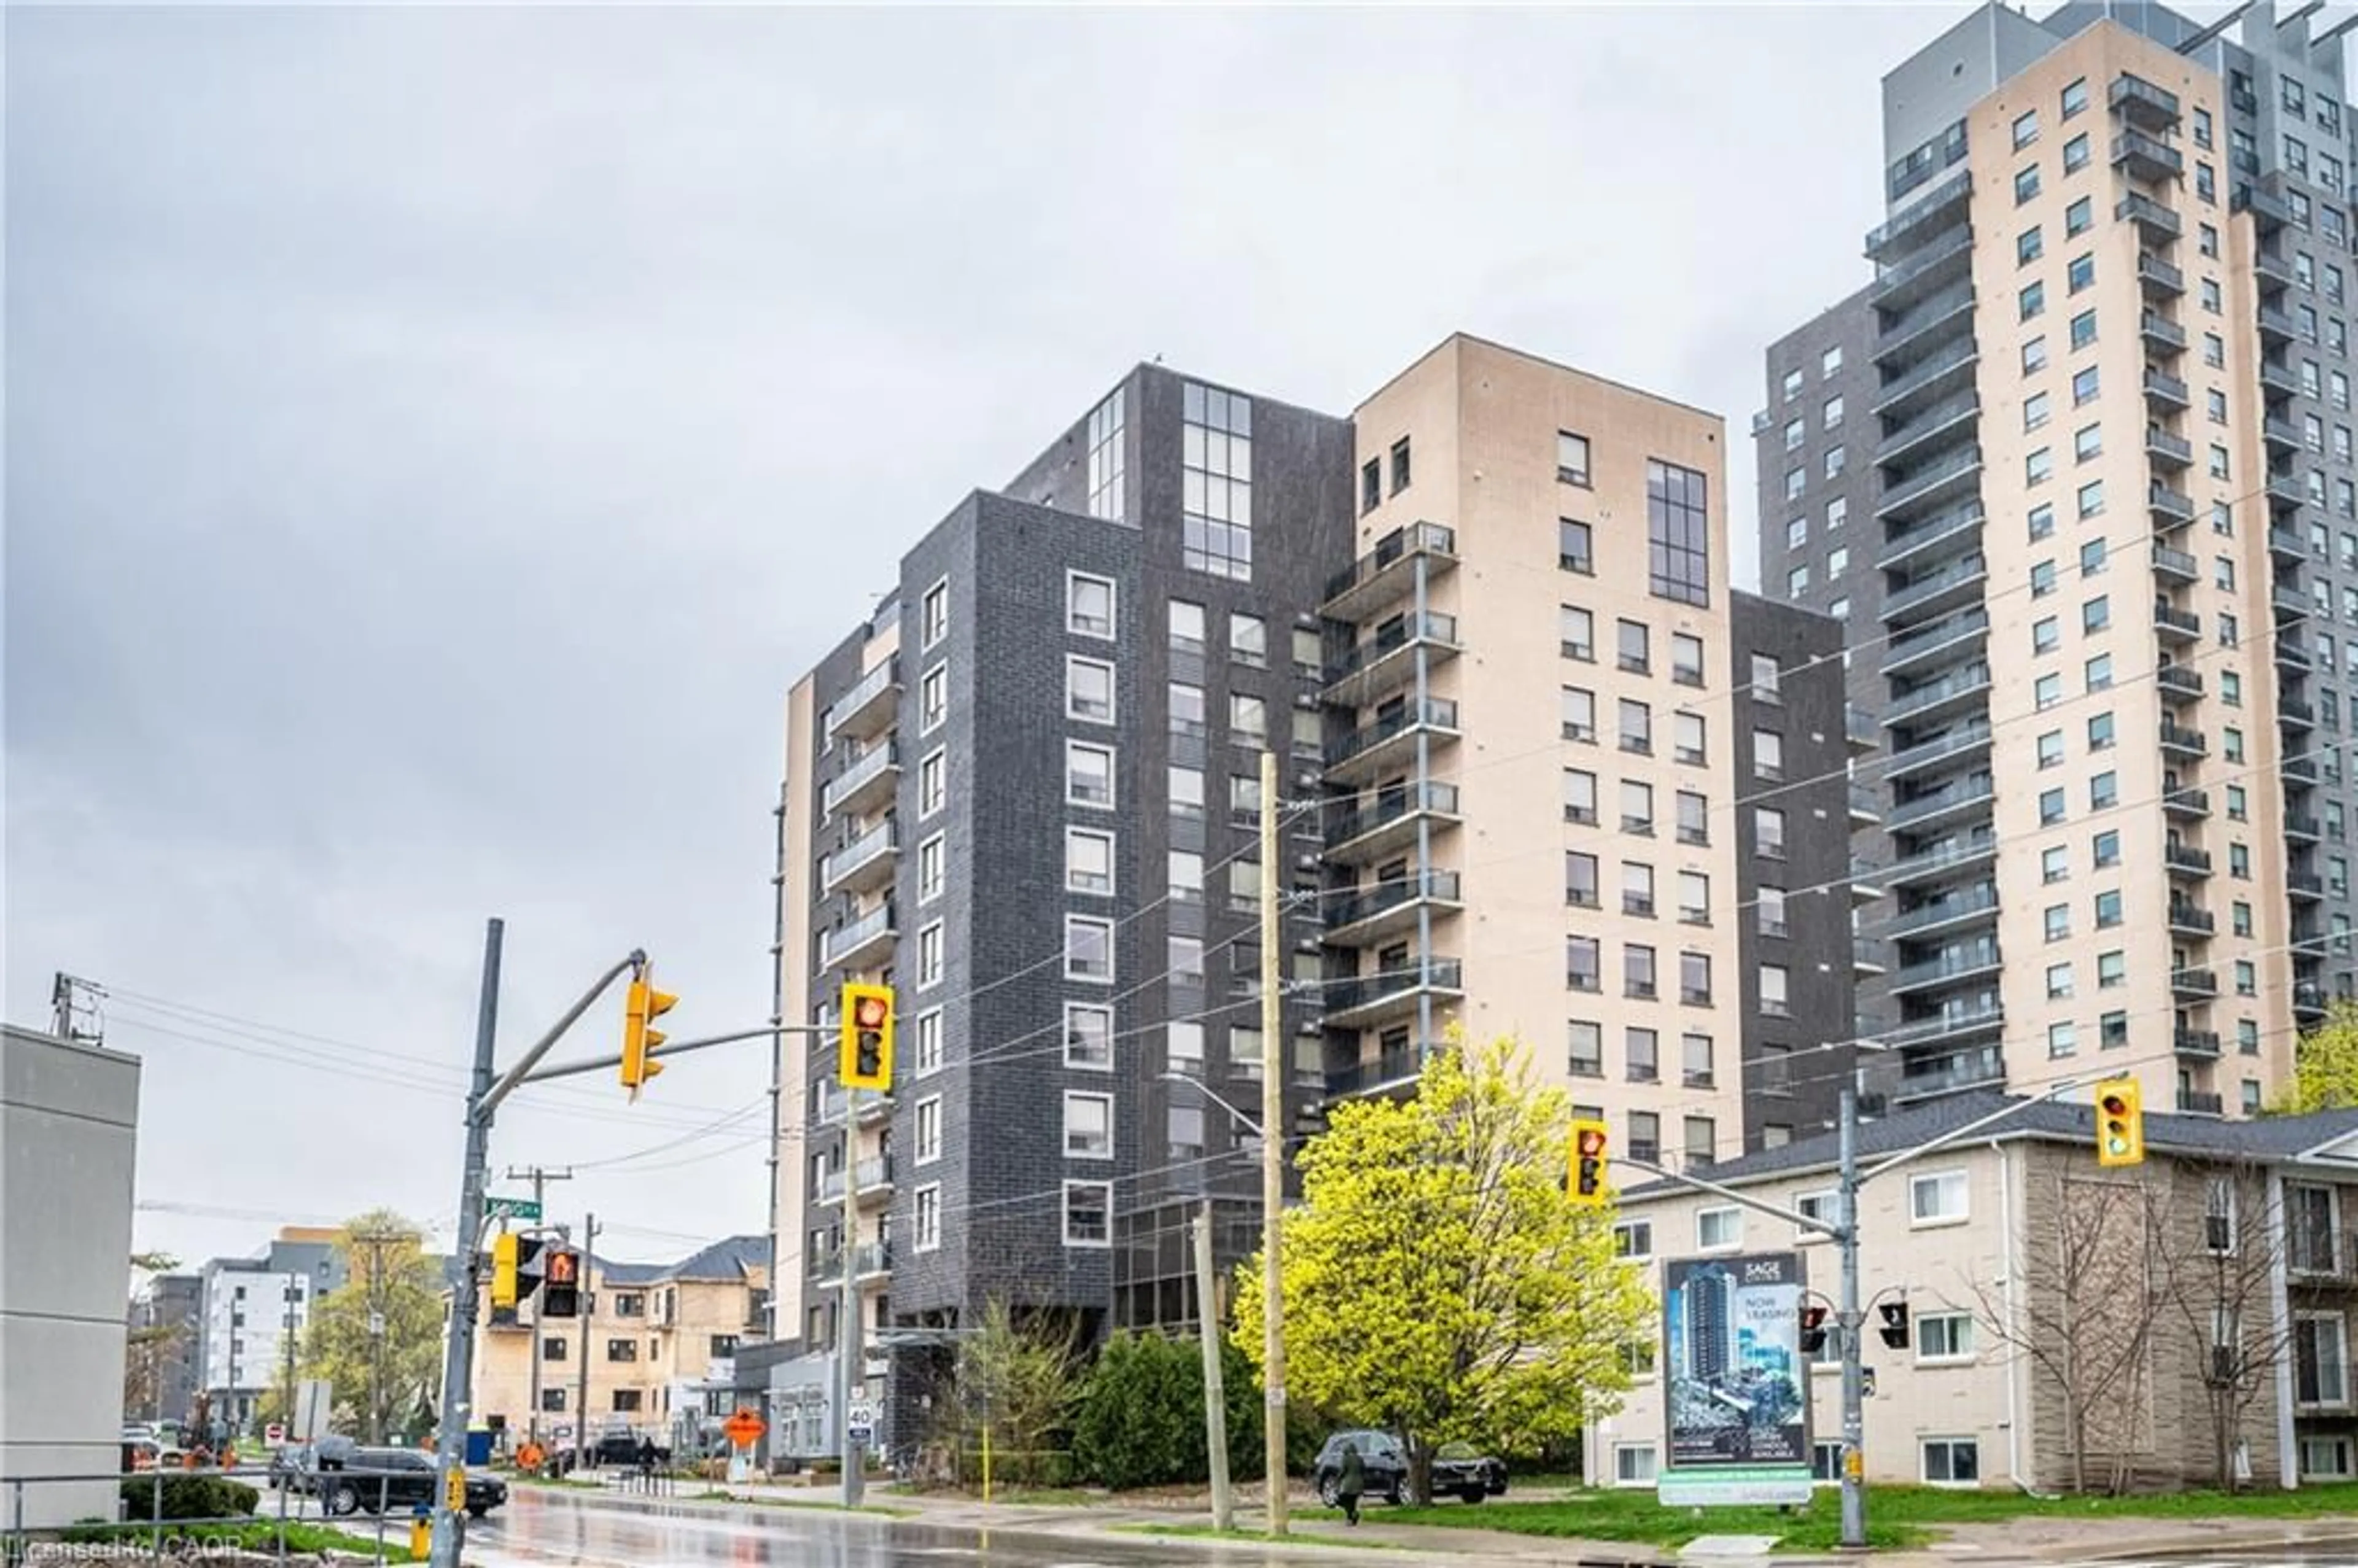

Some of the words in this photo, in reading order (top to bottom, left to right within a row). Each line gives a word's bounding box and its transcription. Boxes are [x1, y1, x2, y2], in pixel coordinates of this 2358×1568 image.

[1746, 1262, 1780, 1275] SAGE
[1746, 1298, 1775, 1308] NOW
[1746, 1308, 1794, 1321] LEASING
[849, 1410, 870, 1423] 40
